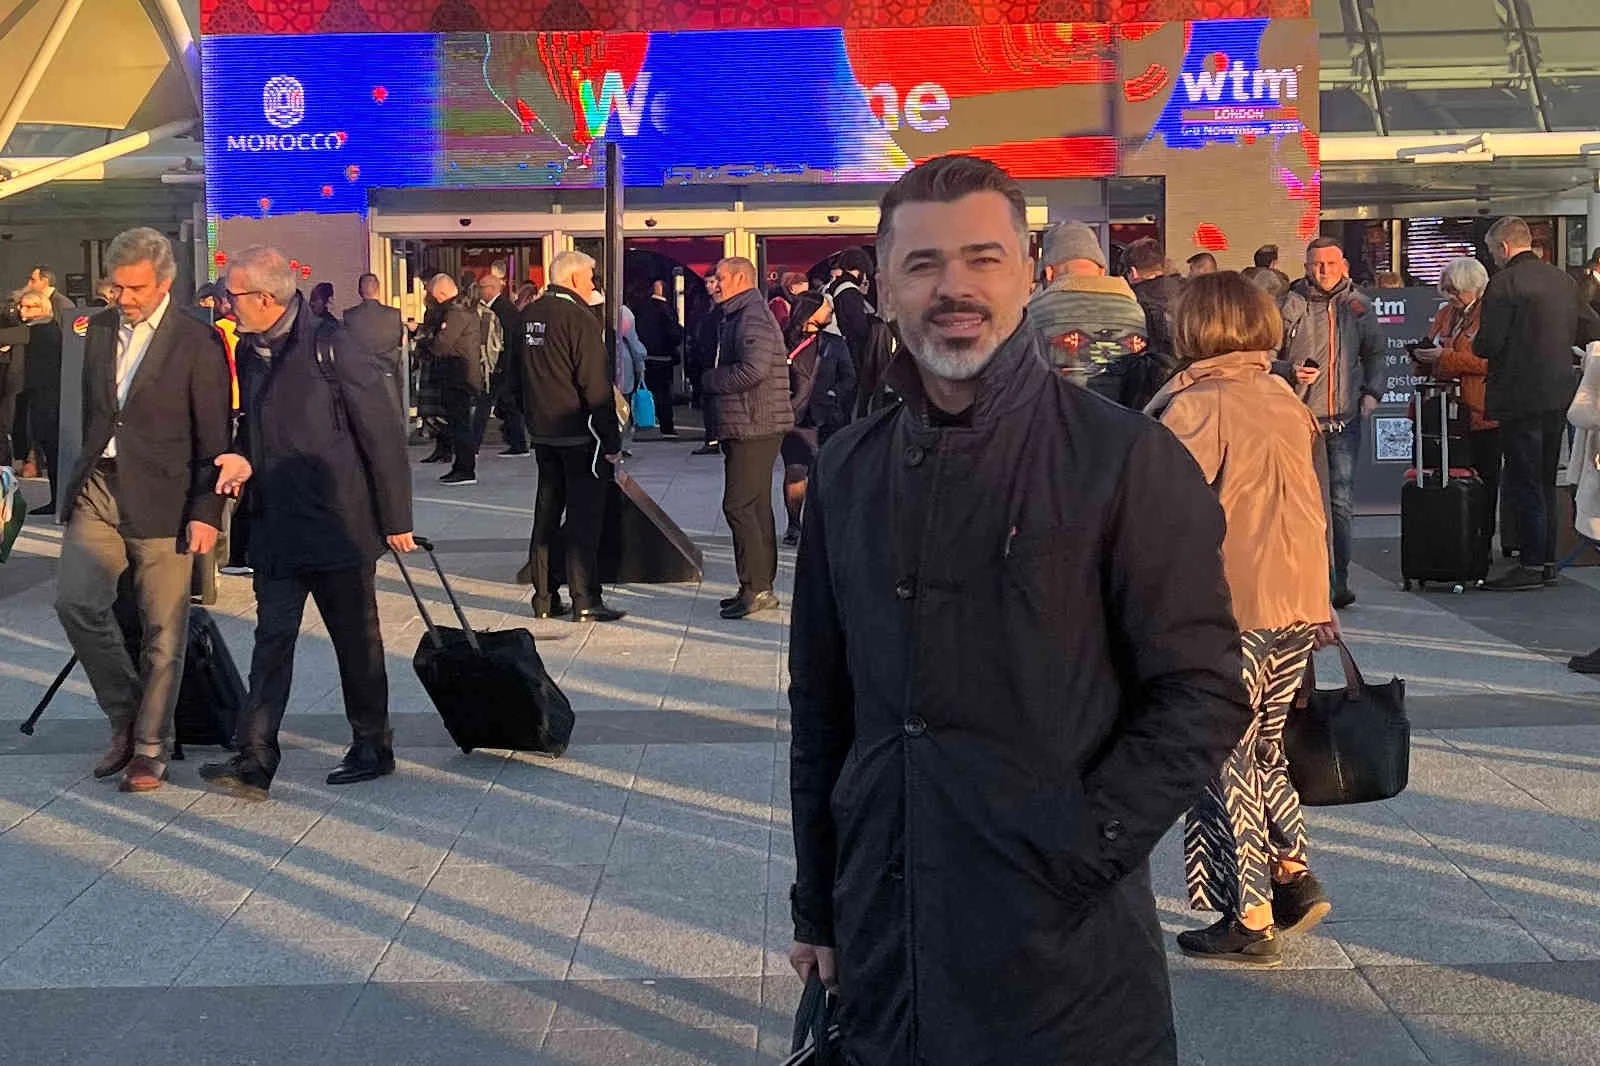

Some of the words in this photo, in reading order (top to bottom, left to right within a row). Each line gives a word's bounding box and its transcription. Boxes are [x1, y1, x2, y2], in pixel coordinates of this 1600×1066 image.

[1181, 60, 1298, 101] wtm
[1214, 108, 1264, 120] LONDON
[227, 133, 342, 151] MOROCCO
[1372, 297, 1405, 316] tm
